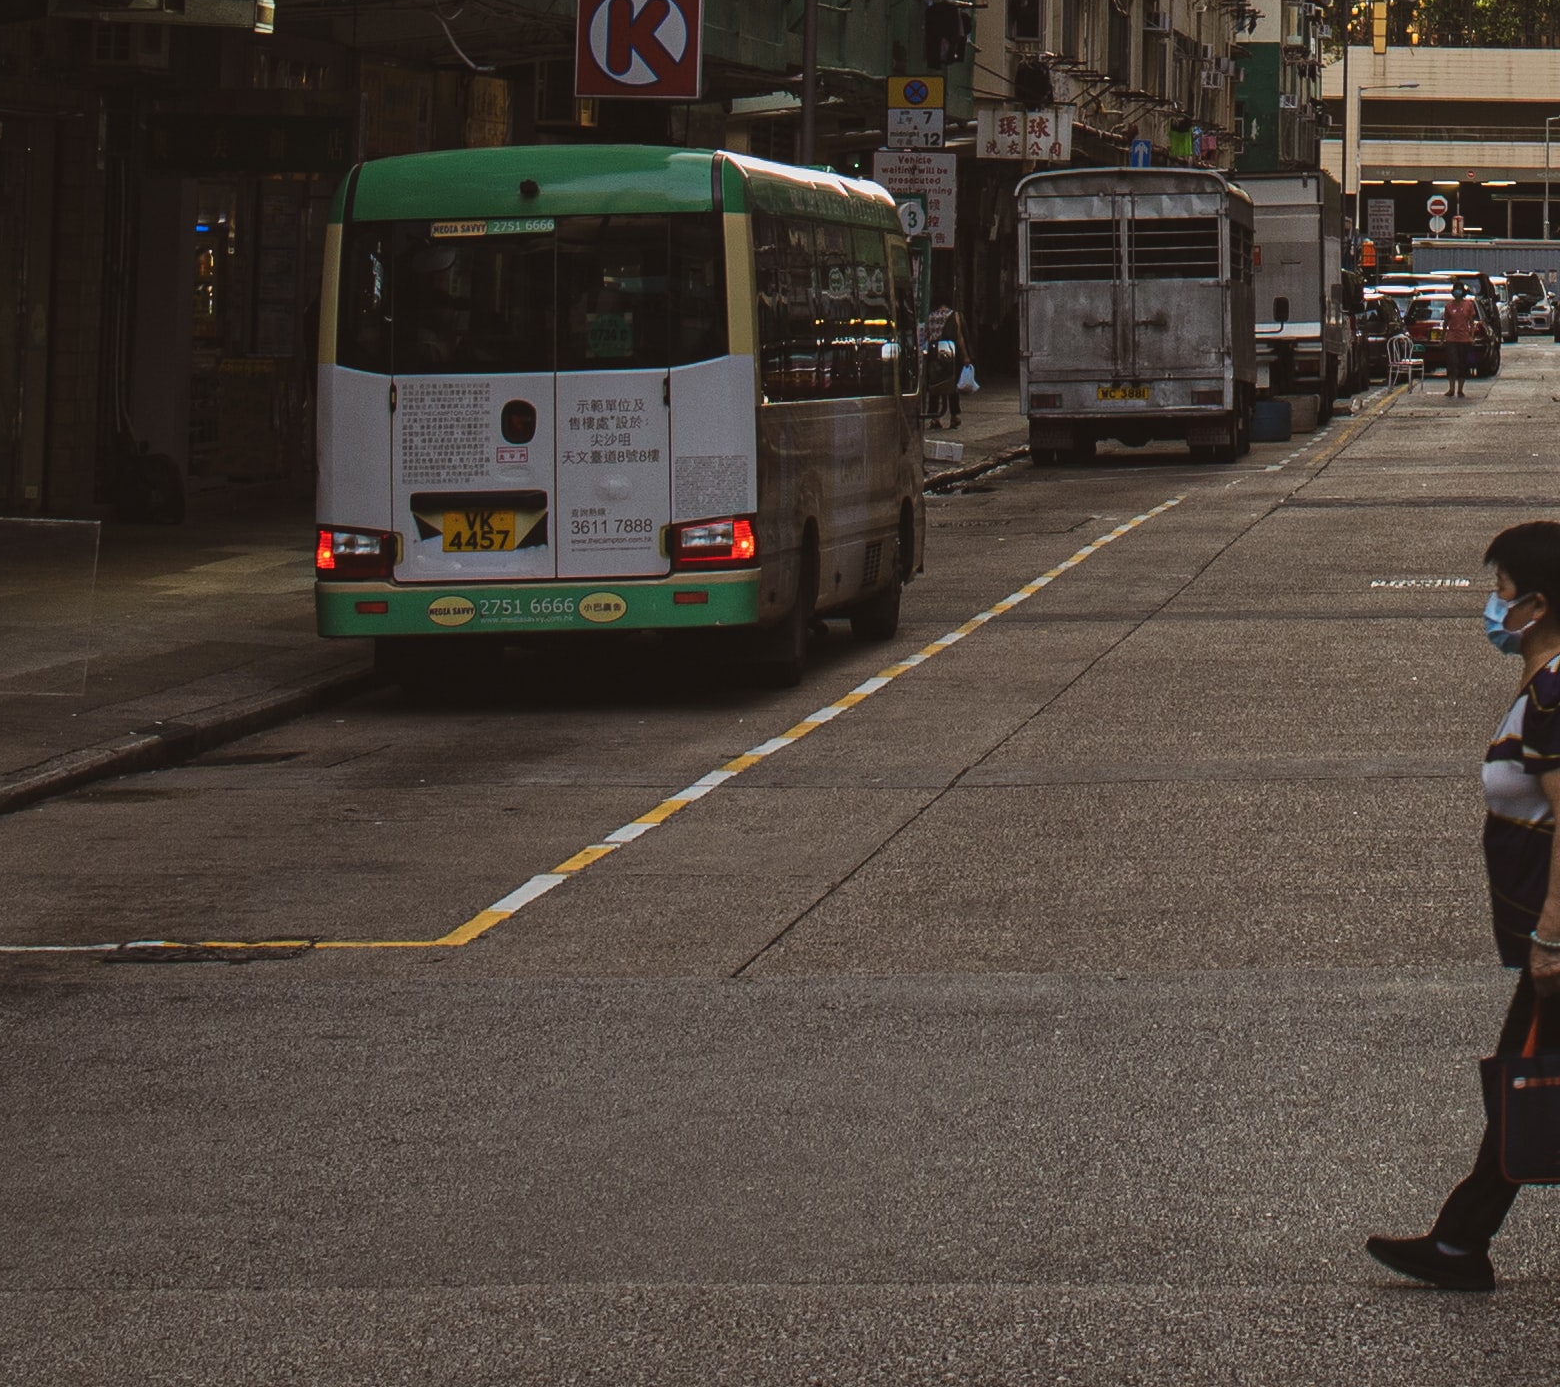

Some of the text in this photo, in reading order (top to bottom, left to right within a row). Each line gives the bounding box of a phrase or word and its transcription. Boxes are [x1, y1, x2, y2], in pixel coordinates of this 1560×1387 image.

[923, 111, 933, 125] 7
[998, 115, 1052, 139] 環球
[923, 132, 940, 146] 12
[985, 141, 1063, 157] 洗衣公司
[898, 155, 932, 165] Vehicle
[919, 166, 936, 175] will
[938, 166, 948, 175] be
[888, 177, 940, 188] prosecuted
[916, 187, 952, 196] warning
[907, 211, 917, 228] 3
[433, 220, 555, 235] MEDIA SAVVY 2751 6666
[576, 399, 646, 414] 示範單位及
[590, 433, 632, 447] 尖沙咀
[466, 512, 492, 530] VK
[571, 519, 653, 535] 3611 7888
[449, 530, 510, 550] 4457
[480, 599, 523, 615] 2751
[530, 598, 575, 614] 6666
